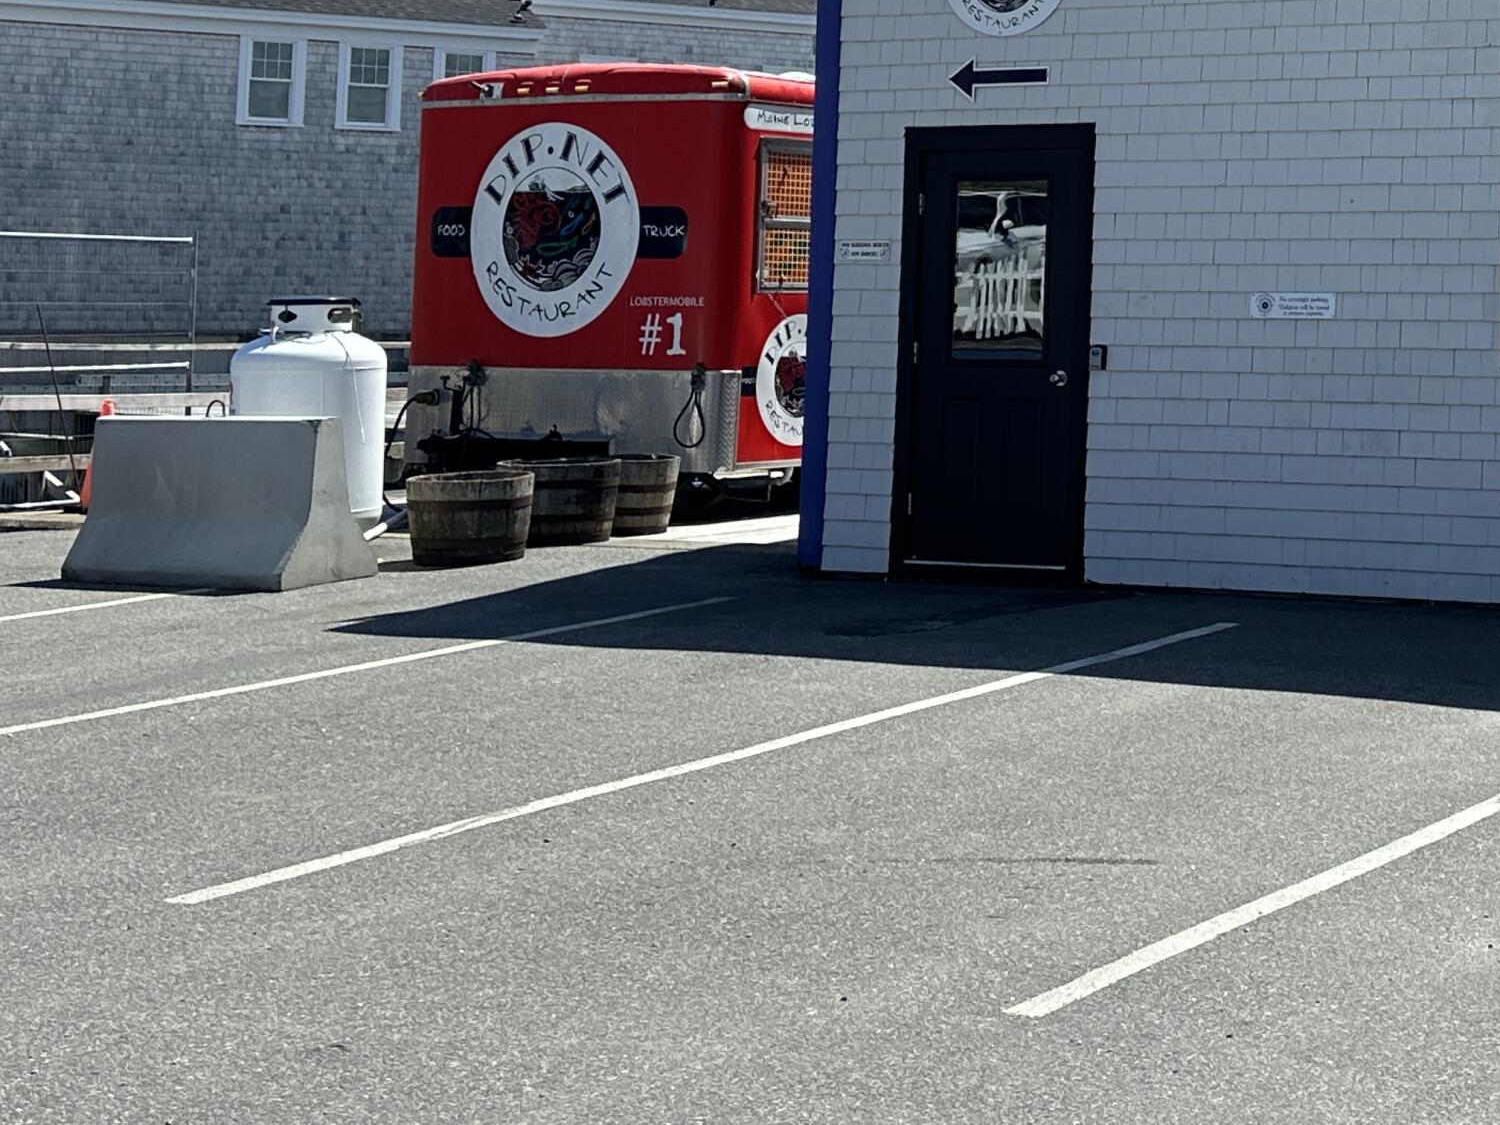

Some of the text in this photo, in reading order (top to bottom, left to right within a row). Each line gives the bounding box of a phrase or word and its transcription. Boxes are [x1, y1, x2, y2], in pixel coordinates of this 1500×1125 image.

[437, 225, 465, 237] FOOD
[643, 225, 685, 237] TRUCK
[486, 261, 613, 321] RESTAURANT
[630, 296, 705, 307] LOBSTERMOBILE
[638, 312, 687, 356] #1
